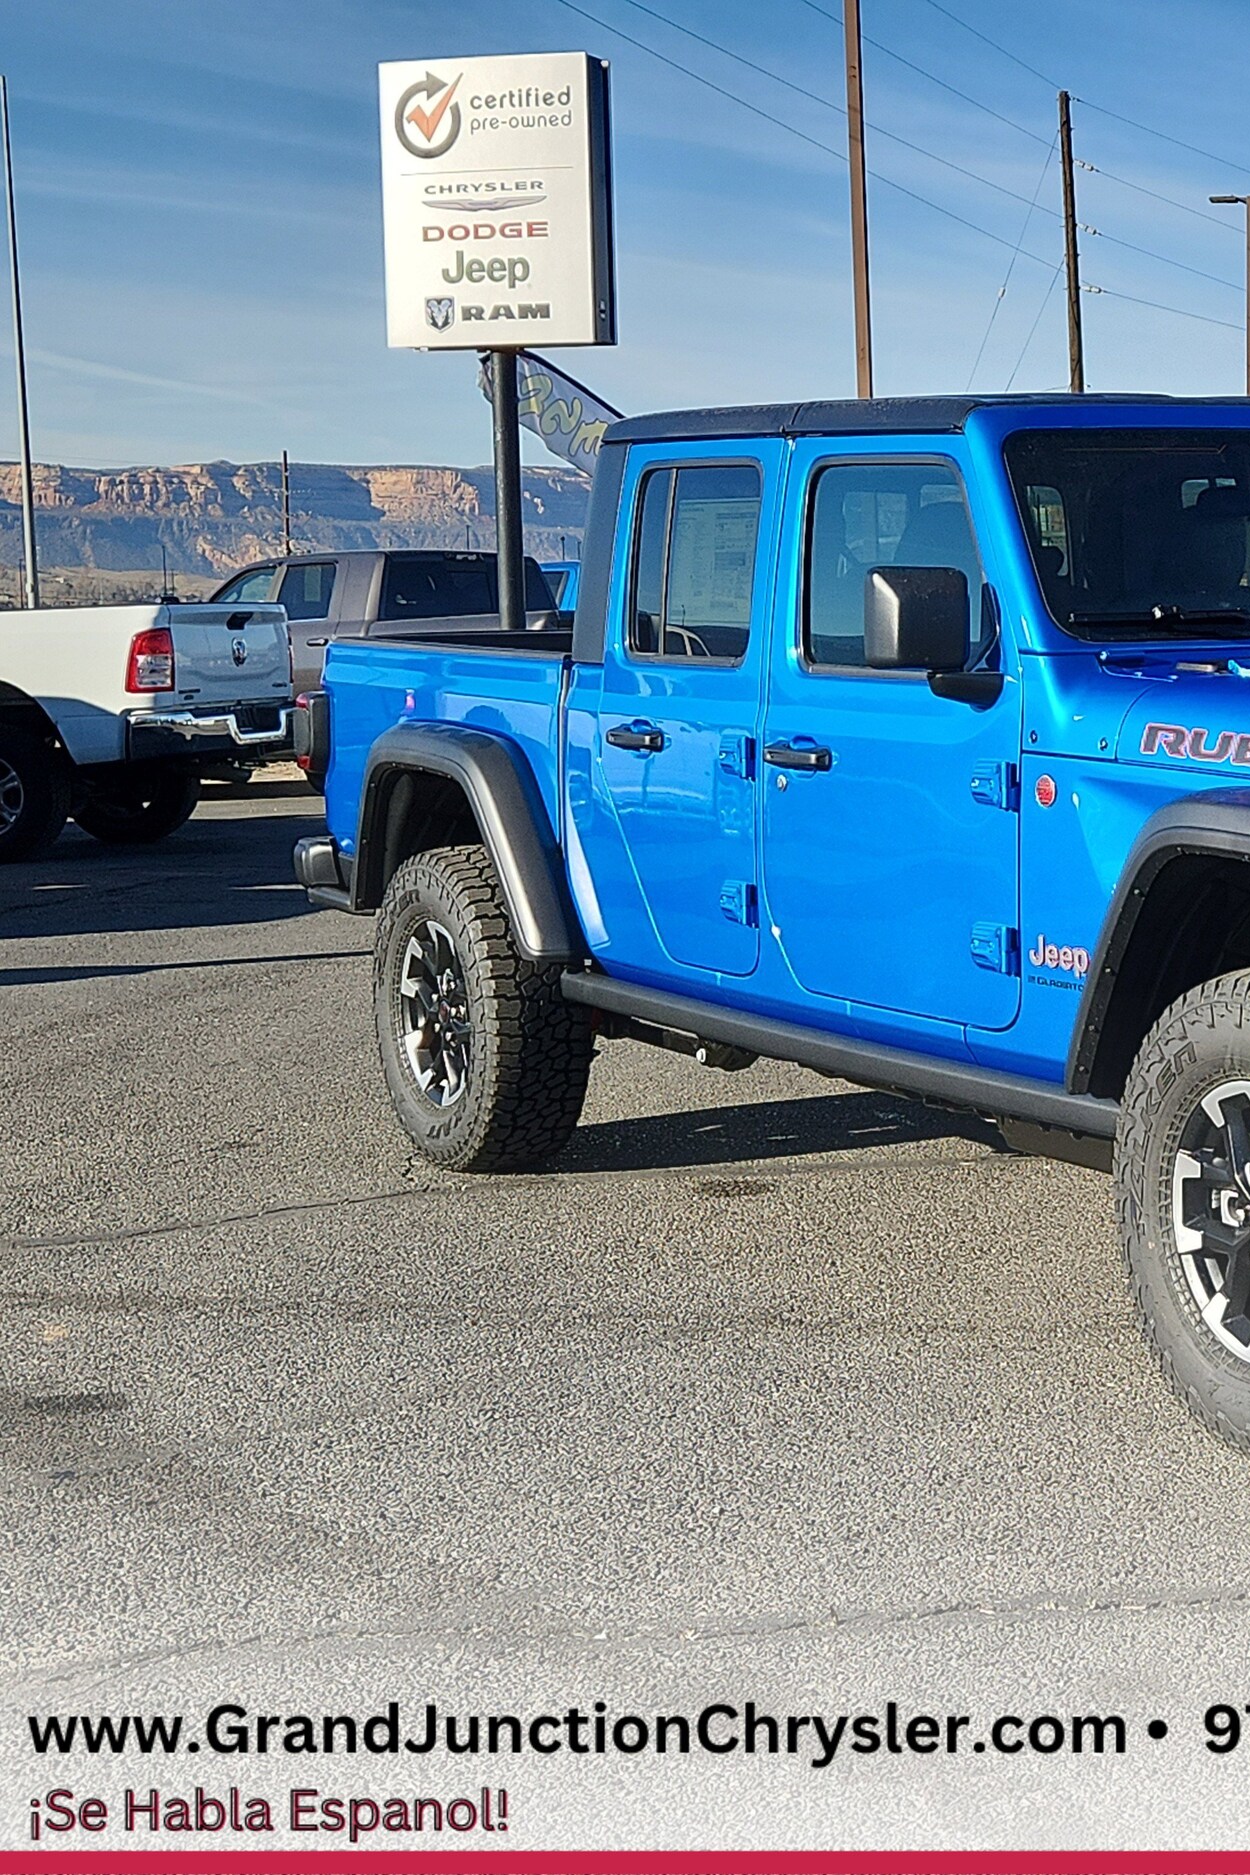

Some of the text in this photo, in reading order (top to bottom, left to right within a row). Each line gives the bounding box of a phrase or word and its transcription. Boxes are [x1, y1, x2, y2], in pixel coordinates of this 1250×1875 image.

[470, 85, 571, 110] certified
[470, 110, 573, 135] pre-owned
[424, 180, 545, 195] CHRYSLER
[422, 221, 549, 242] DODGE
[441, 250, 530, 289] Jeep
[461, 303, 551, 322] RAM
[1029, 933, 1090, 979] Jeep
[1037, 976, 1084, 992] GLADIATO
